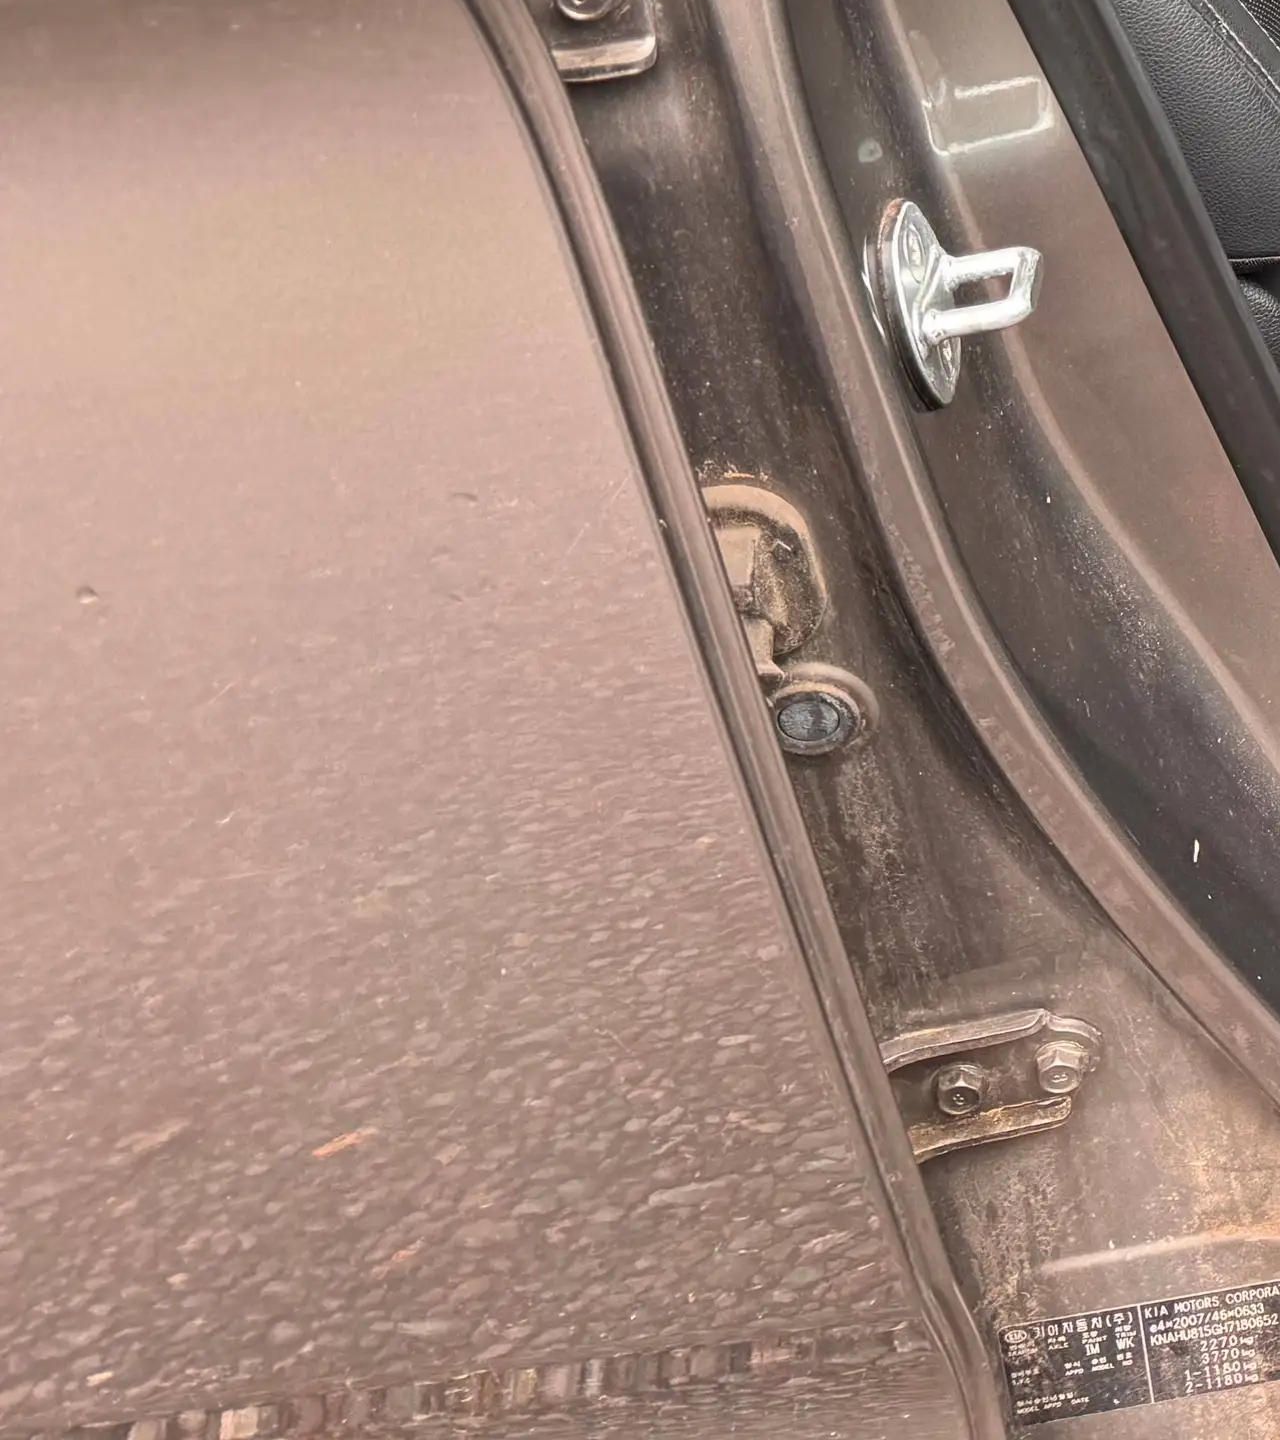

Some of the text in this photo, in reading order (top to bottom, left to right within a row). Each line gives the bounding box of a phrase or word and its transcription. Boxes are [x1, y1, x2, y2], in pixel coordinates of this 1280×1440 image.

[1144, 1305, 1168, 1318] KIA
[1173, 1296, 1220, 1313] MOTORS
[1116, 1337, 1135, 1350] WK
